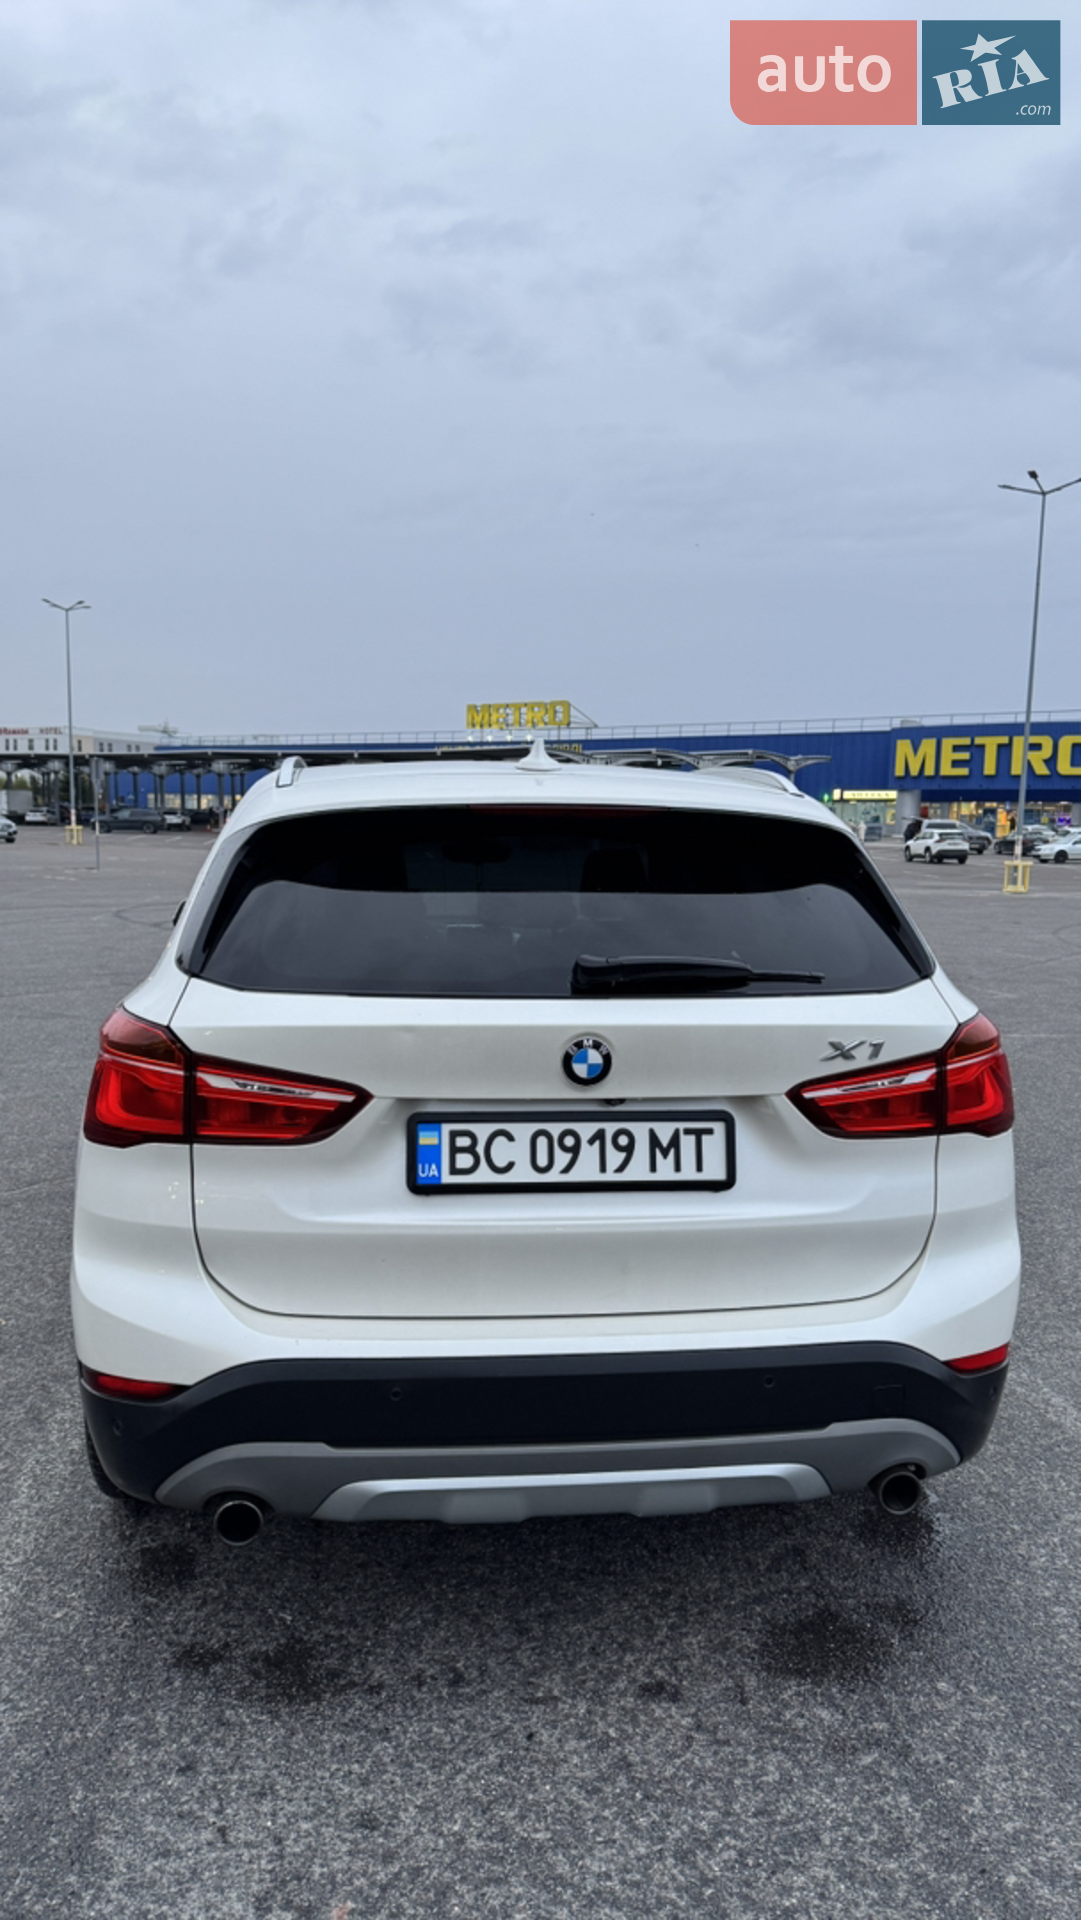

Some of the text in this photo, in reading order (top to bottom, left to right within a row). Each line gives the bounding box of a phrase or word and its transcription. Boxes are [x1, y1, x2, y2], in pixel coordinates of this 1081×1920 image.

[466, 700, 571, 729] METRO
[820, 1039, 886, 1061] X1
[448, 1127, 715, 1175] BC 0919 MT
[418, 1163, 439, 1178] UA
